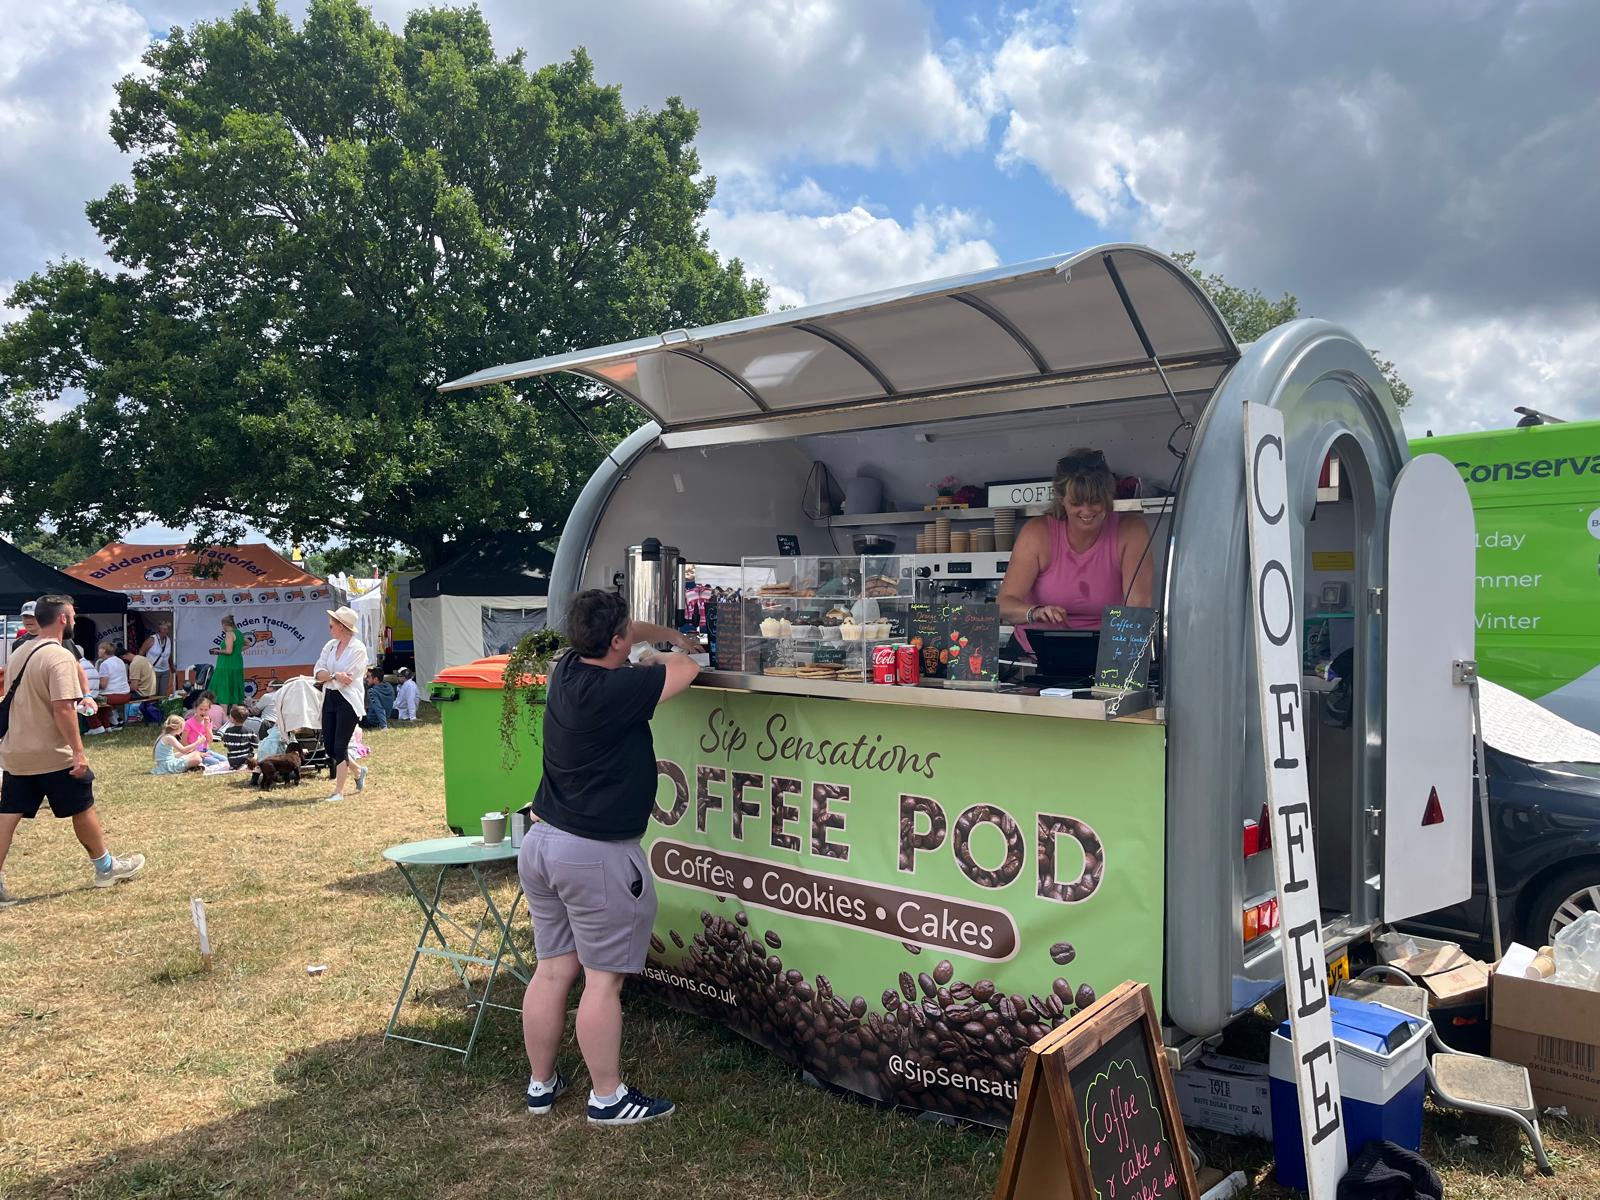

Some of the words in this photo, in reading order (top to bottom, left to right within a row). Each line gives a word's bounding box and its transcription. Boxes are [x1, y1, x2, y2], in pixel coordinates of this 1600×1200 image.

[200, 548, 268, 577] ractorfest
[1475, 574, 1542, 588] mmer
[213, 617, 260, 646] Bidnden
[262, 616, 305, 642] Tractorfest
[700, 708, 747, 762] Sip
[757, 713, 941, 779] Sensations
[1253, 434, 1340, 1147] COFFEE
[650, 759, 851, 863] OFFEE
[897, 793, 1105, 905] POD
[664, 848, 735, 889] Coffee
[761, 872, 867, 921] Cookies
[897, 901, 994, 951] Cakes
[641, 967, 737, 1007] nsations.co.uk
[888, 1054, 1018, 1101] @SipSensati
[1091, 1086, 1139, 1153] Coffee
